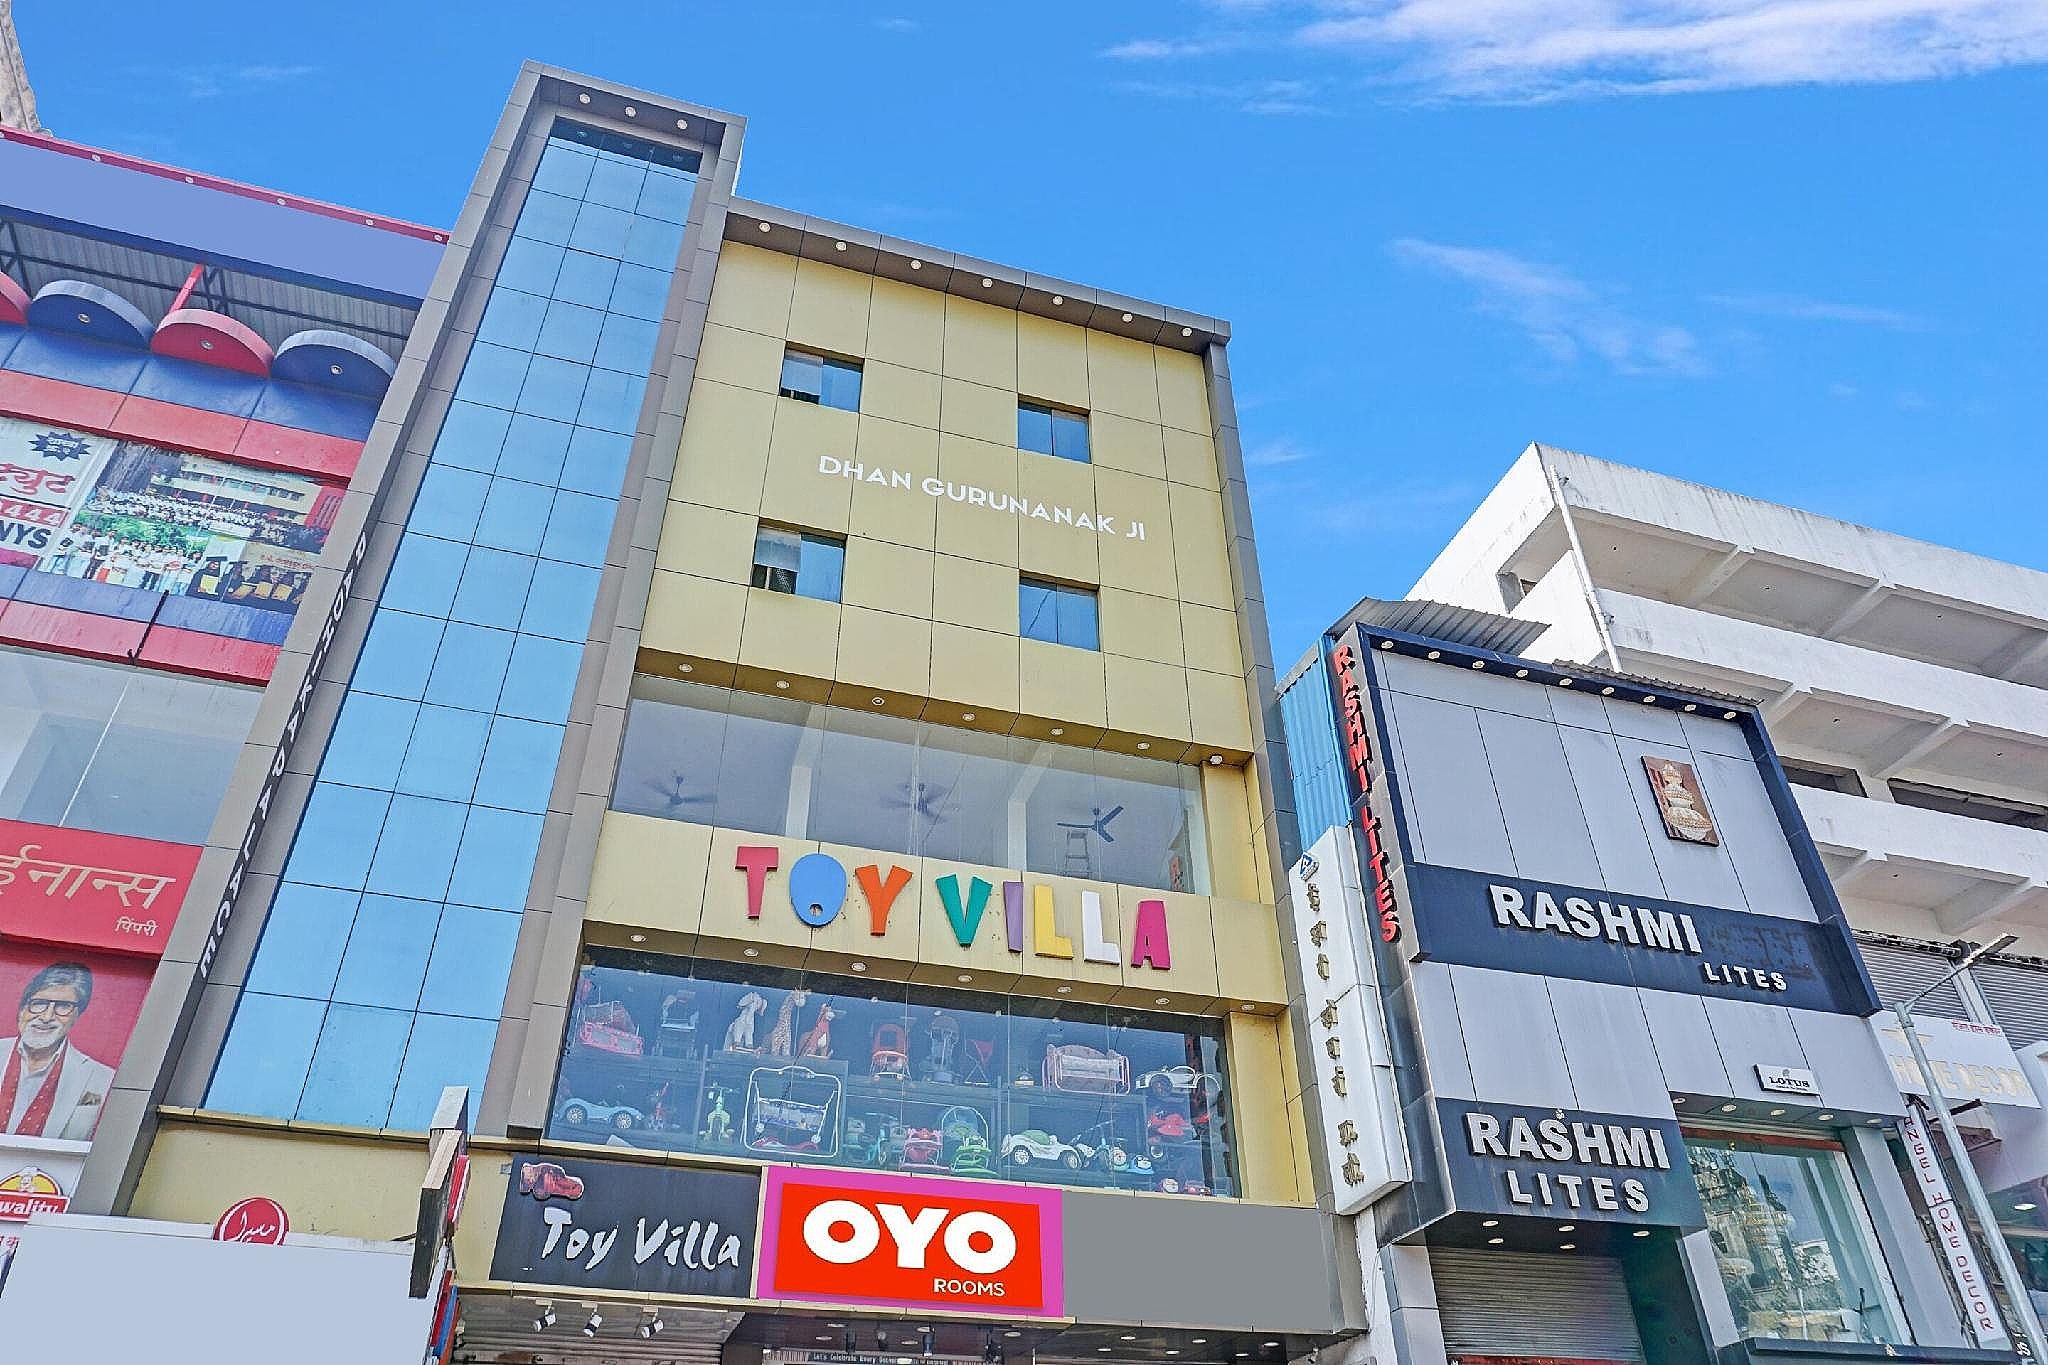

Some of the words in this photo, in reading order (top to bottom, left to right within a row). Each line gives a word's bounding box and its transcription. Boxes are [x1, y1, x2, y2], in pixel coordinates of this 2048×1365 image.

[0, 502, 61, 526] 444
[819, 455, 911, 490] DHAN
[921, 477, 1115, 535] GURUNANAK
[1126, 521, 1146, 541] JI
[286, 530, 369, 743] RADHIKA
[1333, 645, 1375, 794] RASHMI
[1359, 804, 1401, 944] LITES
[199, 745, 286, 979] PALACE
[735, 846, 913, 936] TOY
[935, 873, 1172, 971] VILLA
[1488, 884, 1702, 954] RASHMI
[1703, 961, 1788, 991] LITES
[1768, 1076, 1810, 1088] LOTUS
[1465, 1112, 1671, 1170] RASHMI
[1507, 1169, 1649, 1213] LITES
[1903, 1115, 1936, 1185] ANGEL
[1931, 1193, 1961, 1250] HOME
[541, 1206, 619, 1271] Toy
[633, 1217, 740, 1272] Villa
[802, 1199, 1018, 1275] OYO
[933, 1277, 1006, 1298] ROOMS
